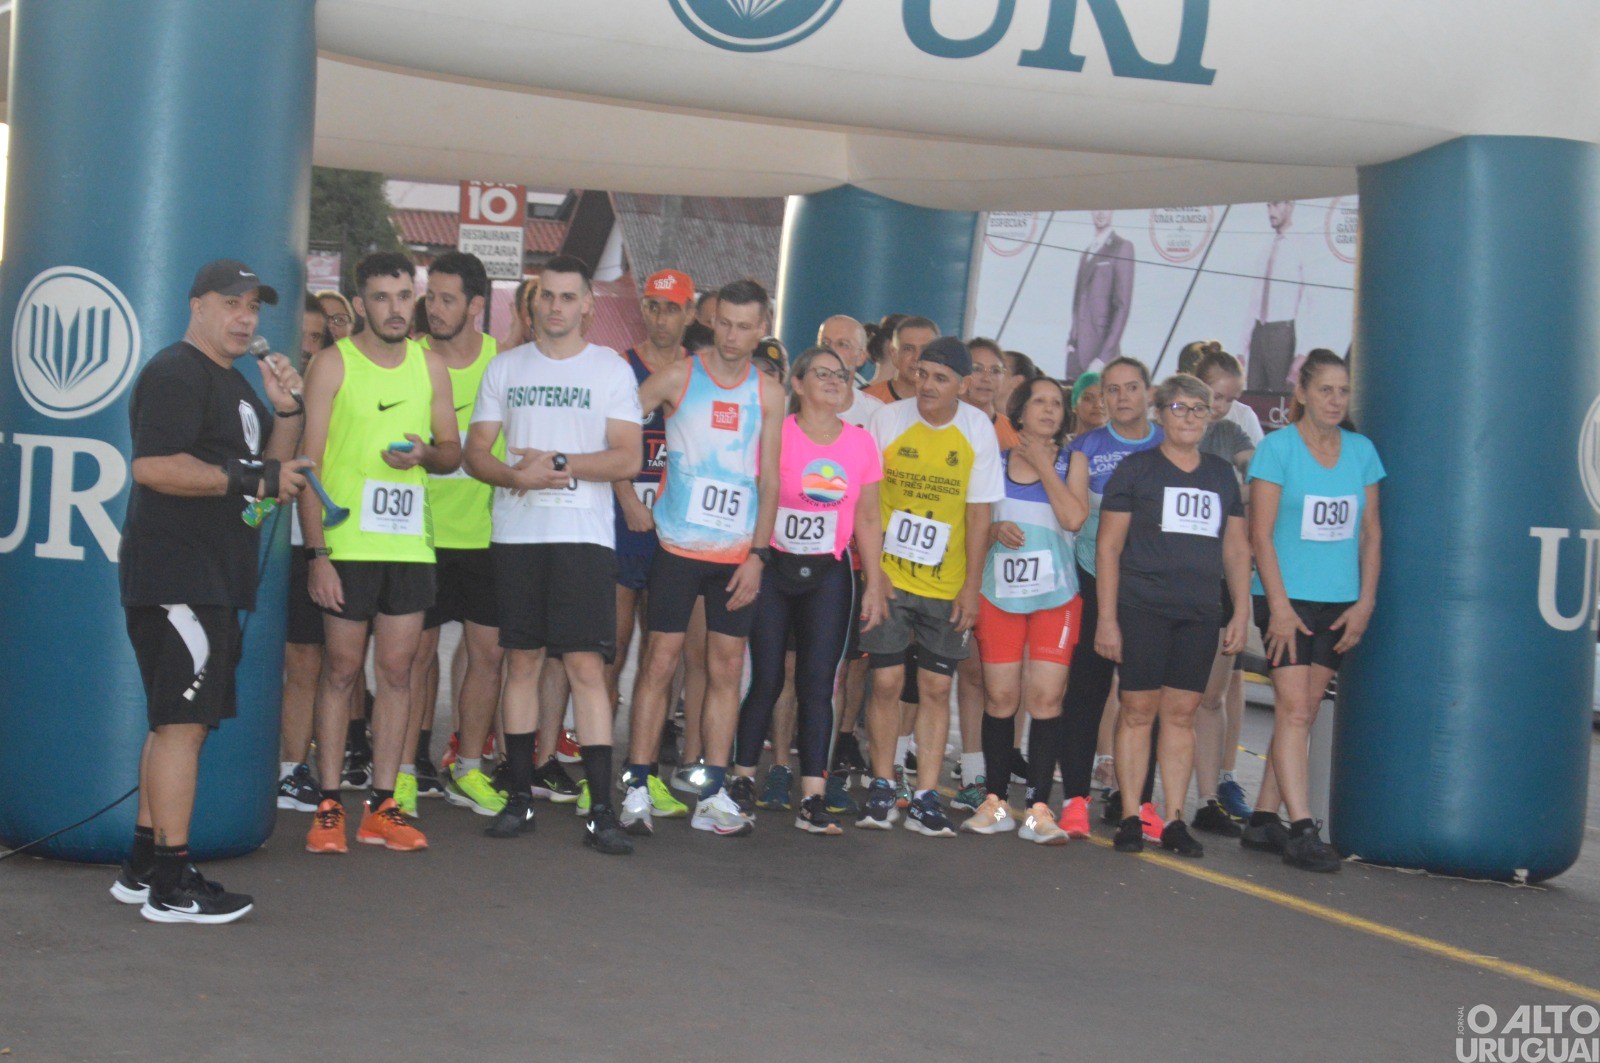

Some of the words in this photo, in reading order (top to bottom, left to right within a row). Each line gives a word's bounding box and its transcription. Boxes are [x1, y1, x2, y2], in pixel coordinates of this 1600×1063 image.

[469, 187, 517, 223] 10
[462, 229, 519, 242] RESTAURANTE
[472, 244, 518, 256] PIZZARIA
[507, 386, 591, 409] FISIOTERAPIA
[648, 460, 667, 468] TAR
[886, 469, 926, 481] RÚSTICA
[928, 475, 961, 487] CIDADE
[900, 480, 922, 490] TRÊS
[925, 483, 960, 495] PASSOS
[373, 487, 413, 516] 030
[702, 485, 741, 516] 015
[916, 491, 940, 501] ANOS
[1176, 493, 1211, 519] 018
[1313, 500, 1349, 525] 030
[785, 514, 825, 540] 023
[897, 518, 937, 550] 019
[1003, 557, 1039, 583] 027
[281, 783, 299, 796] FILA
